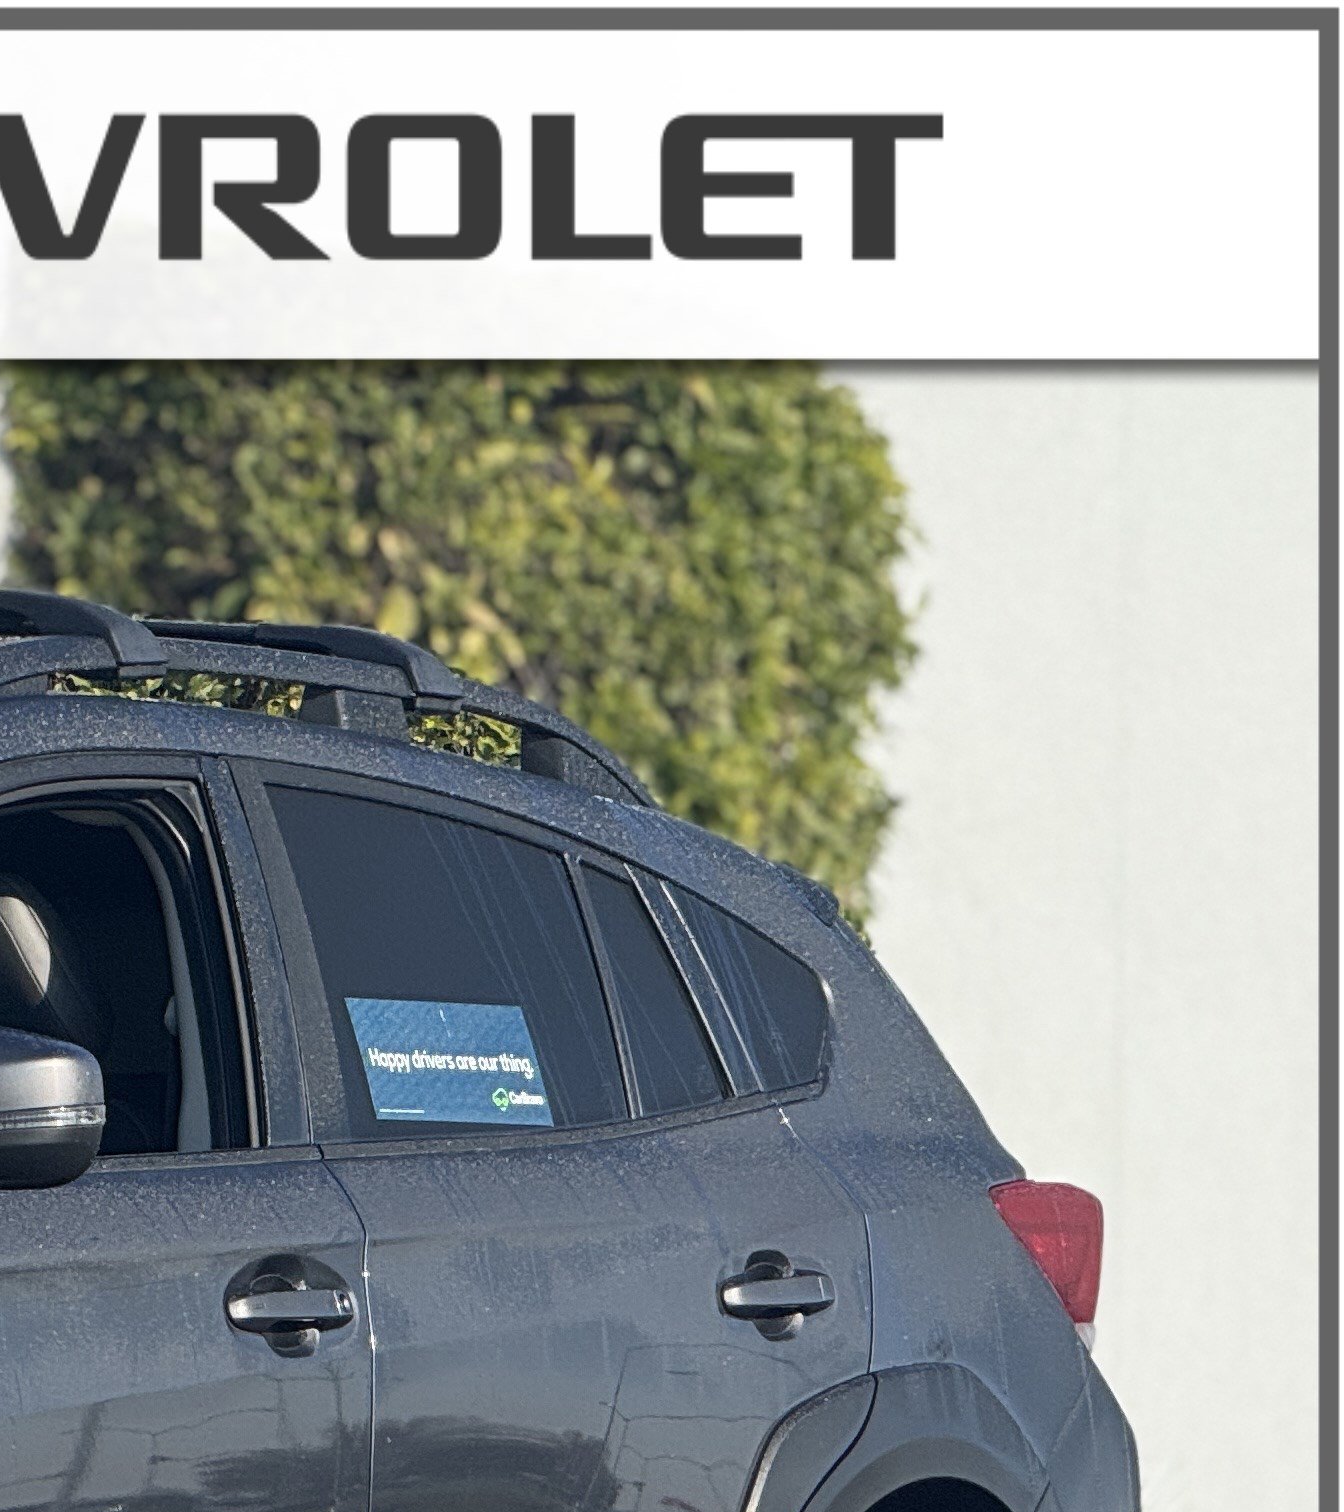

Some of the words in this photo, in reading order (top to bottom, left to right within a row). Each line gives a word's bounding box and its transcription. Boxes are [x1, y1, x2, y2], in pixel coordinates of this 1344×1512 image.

[368, 1047, 411, 1073] Happy
[412, 1050, 455, 1069] drivers
[455, 1055, 477, 1071] are
[478, 1056, 499, 1071] our
[499, 1053, 534, 1080] thing.
